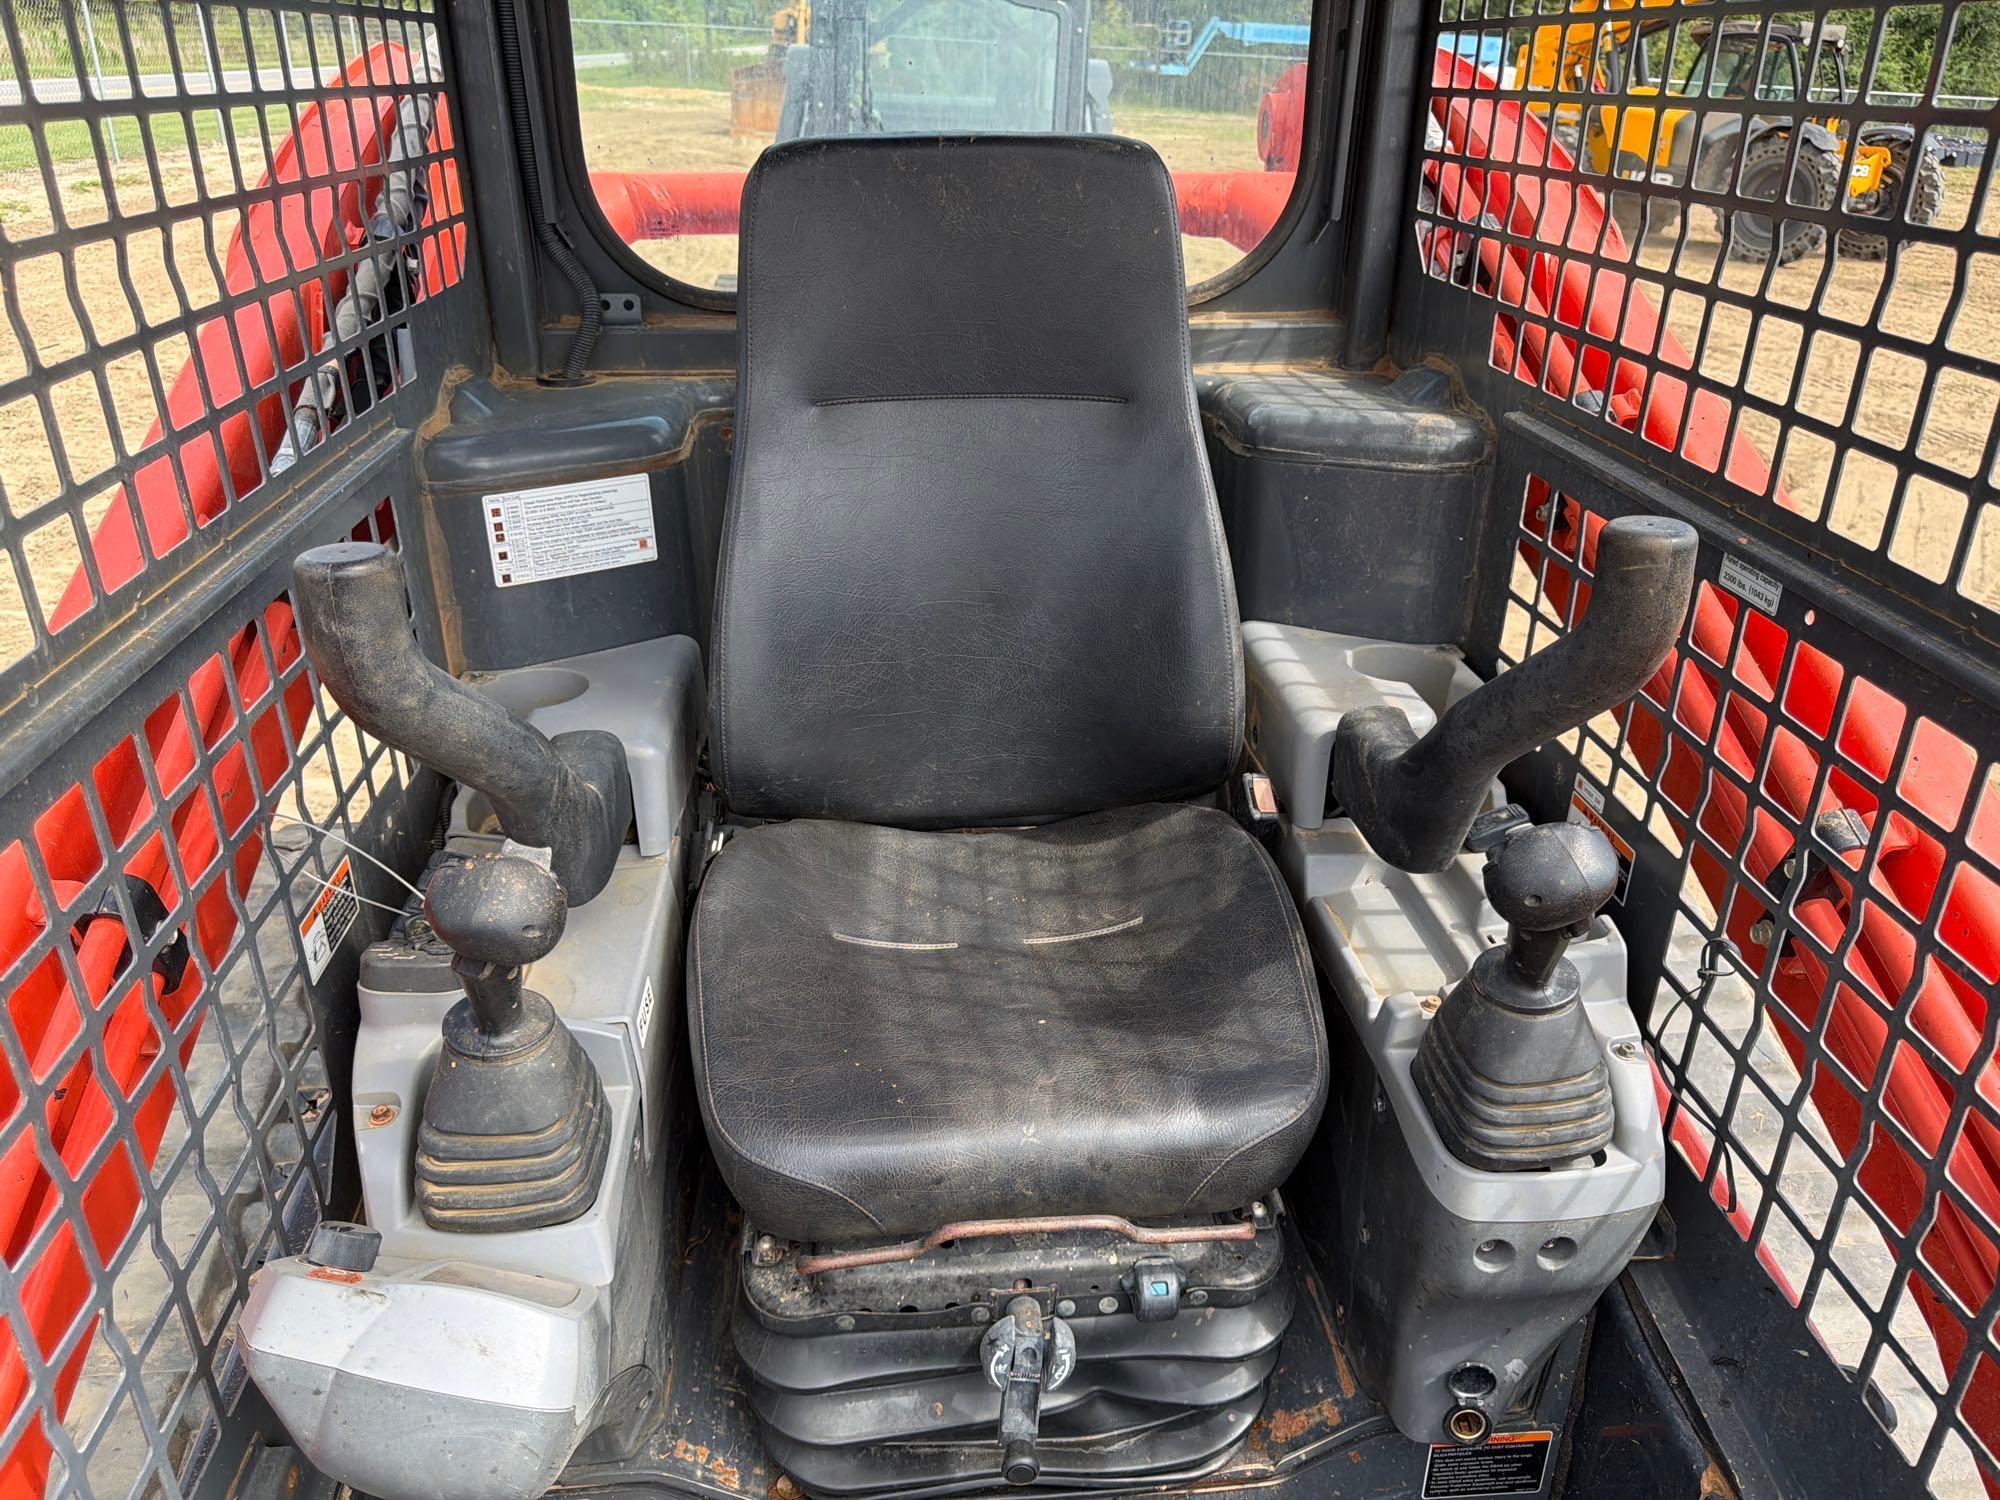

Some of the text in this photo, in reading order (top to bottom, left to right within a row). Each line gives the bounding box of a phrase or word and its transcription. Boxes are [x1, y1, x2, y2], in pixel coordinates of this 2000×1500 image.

[1852, 163, 1870, 177] CB
[1723, 571, 1775, 608] 2300 lbs. (1043 kg)
[1738, 562, 1760, 581] operating
[1760, 574, 1780, 591] capacity
